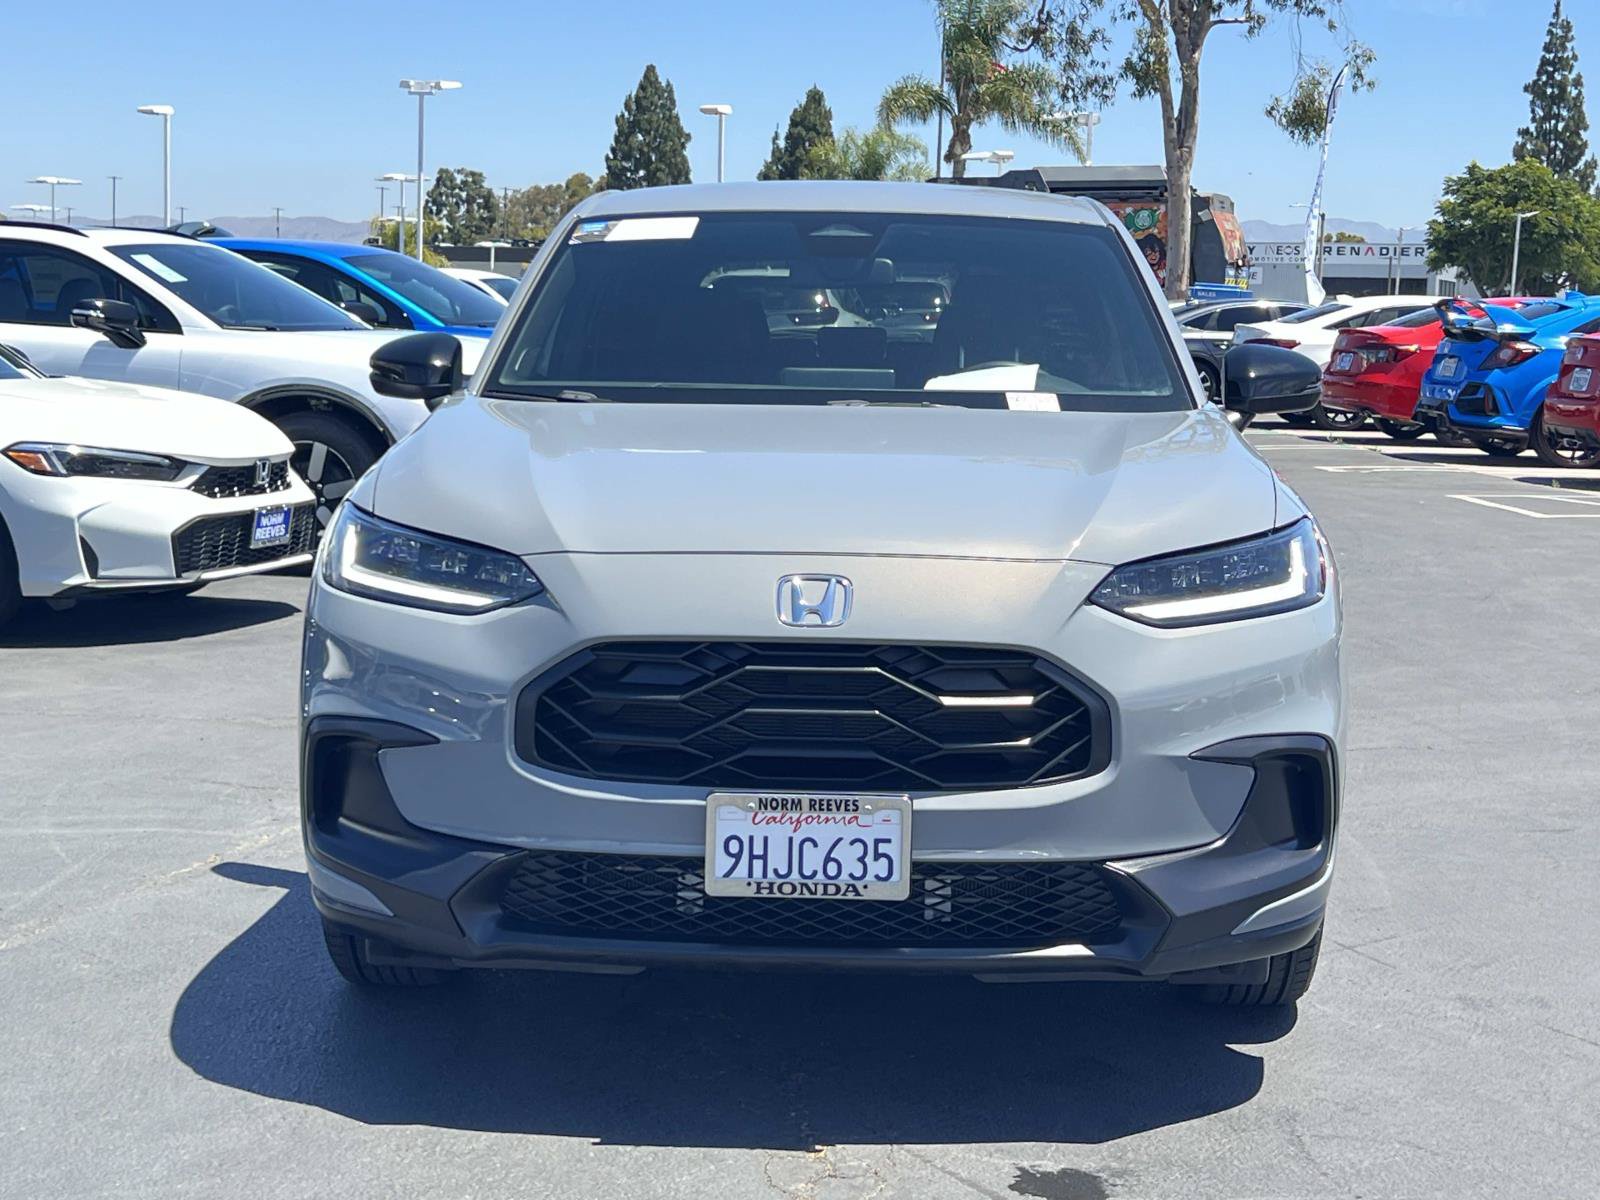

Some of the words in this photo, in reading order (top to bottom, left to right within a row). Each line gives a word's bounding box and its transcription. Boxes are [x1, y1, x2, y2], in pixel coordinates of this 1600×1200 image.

[1315, 245, 1426, 257] RENADIER
[255, 524, 286, 540] REEVES
[757, 797, 803, 812] NORM
[809, 798, 860, 813] REEVES
[751, 811, 873, 833] California
[722, 834, 895, 882] 9HJC635
[753, 881, 864, 897] HONDA
